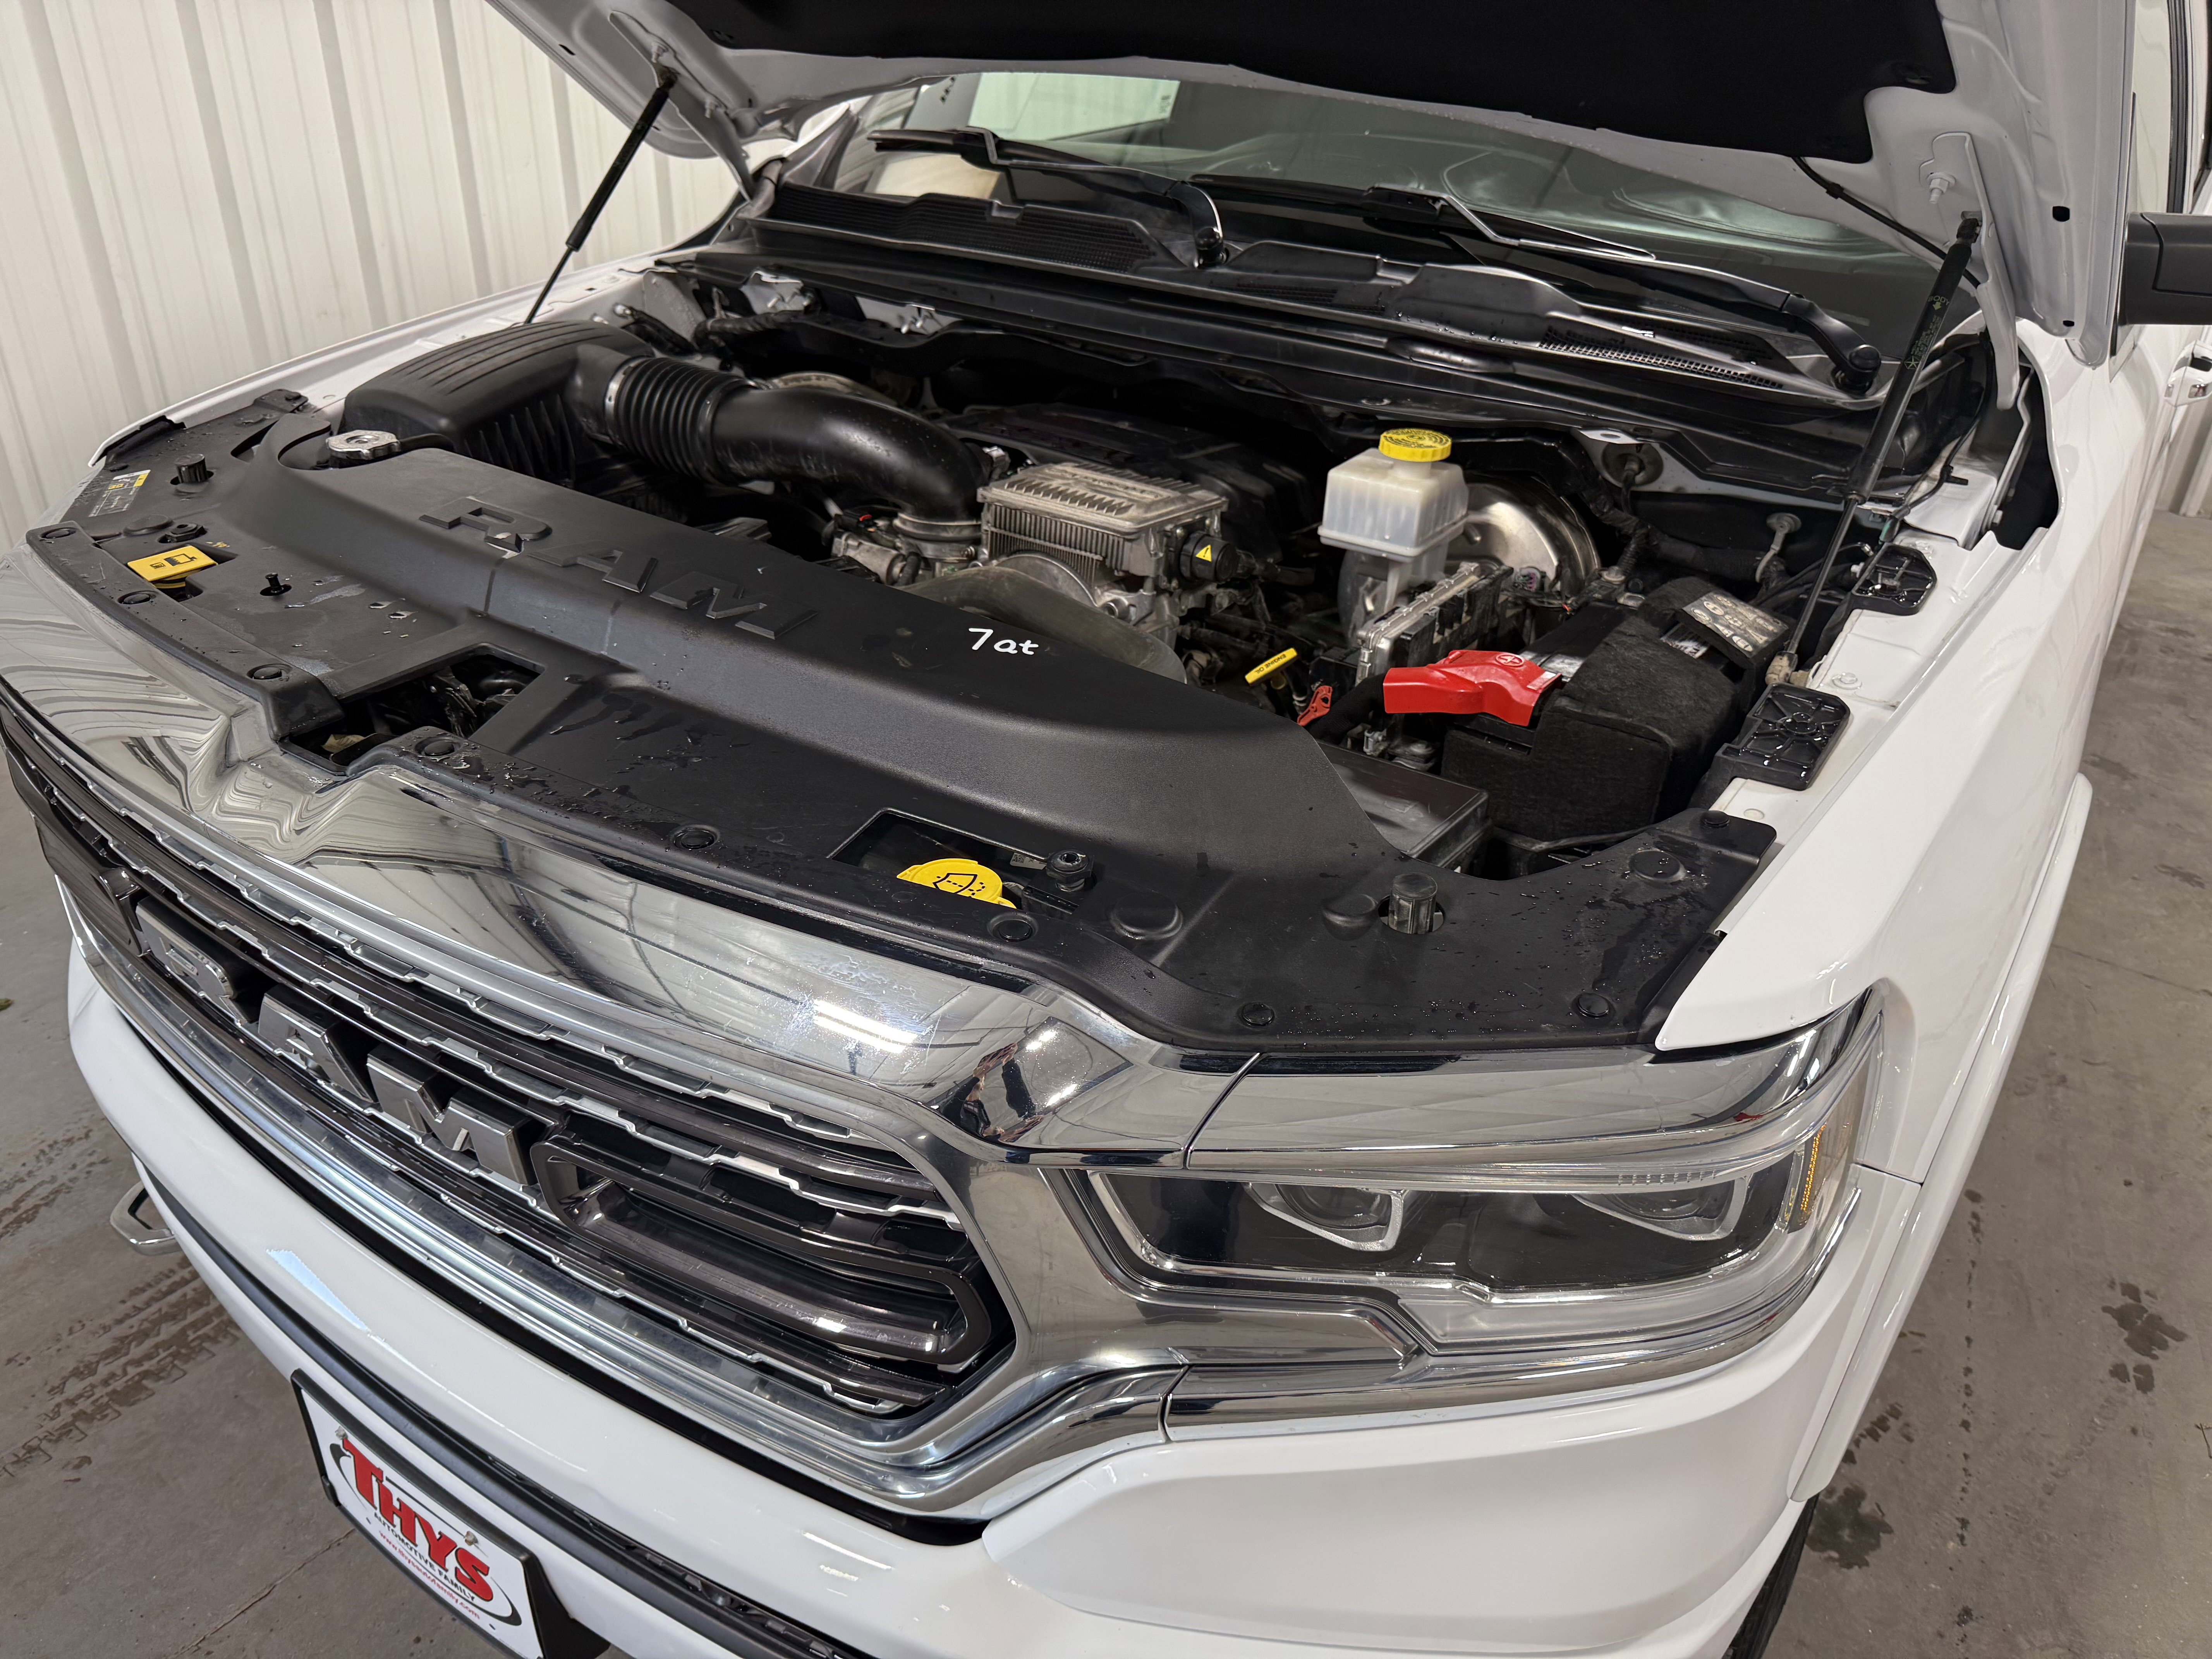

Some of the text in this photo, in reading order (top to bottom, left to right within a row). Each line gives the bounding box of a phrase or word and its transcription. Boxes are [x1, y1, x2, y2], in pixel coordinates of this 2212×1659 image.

[1927, 295, 1950, 306] BODY
[419, 496, 818, 639] RAM
[1264, 654, 1286, 668] ENGINE
[136, 895, 543, 1186] RAM
[342, 1437, 494, 1602] THYS
[374, 1512, 475, 1602] AUTOMOTIVE FAMILY
